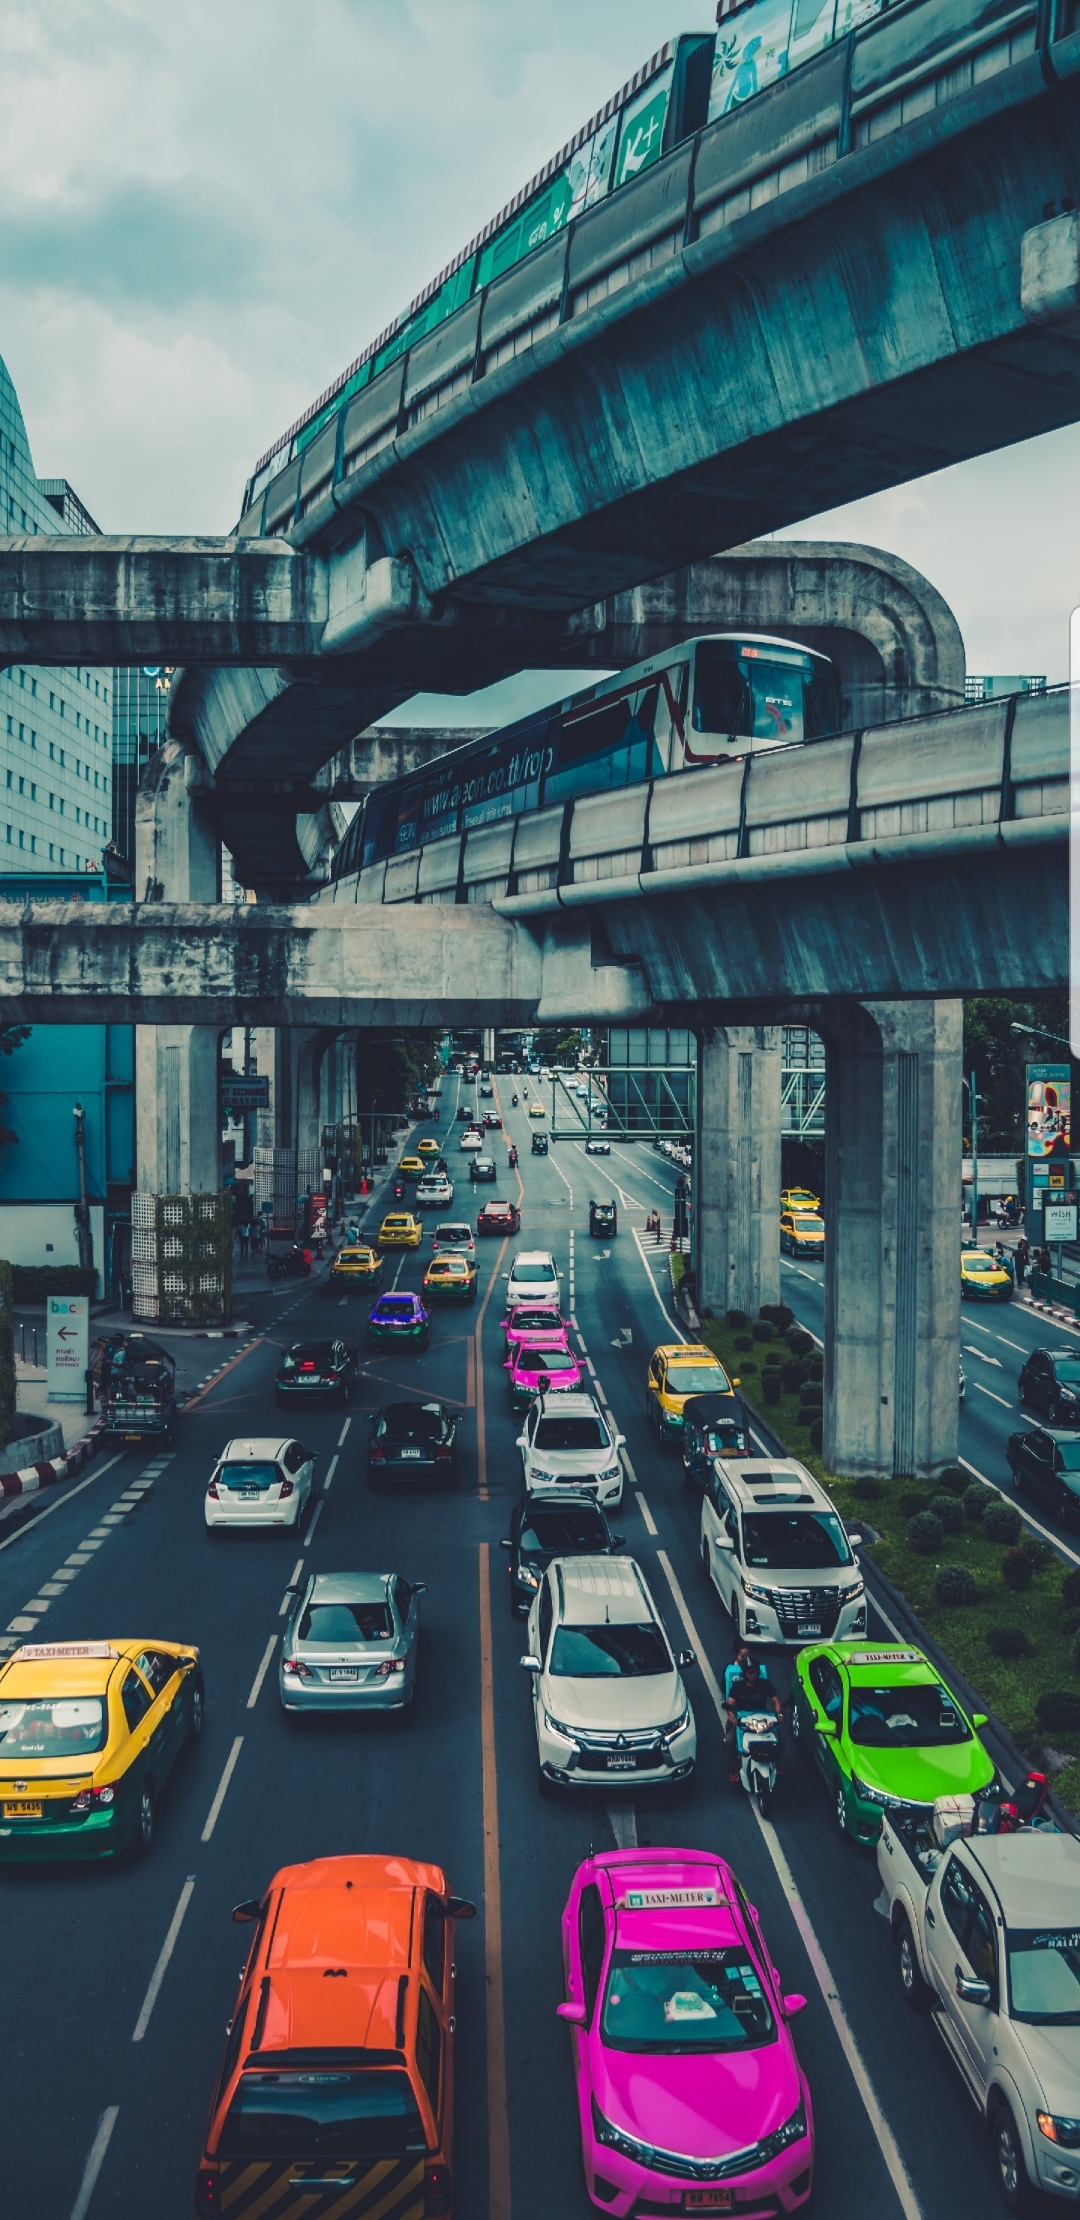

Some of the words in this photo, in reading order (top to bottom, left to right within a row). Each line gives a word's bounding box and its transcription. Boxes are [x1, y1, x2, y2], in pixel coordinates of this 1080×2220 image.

[765, 696, 793, 707] BTS
[233, 1088, 266, 1096] EXCHANGE
[22, 1802, 41, 1811] 5435
[644, 1892, 704, 1905] TAXI-METER
